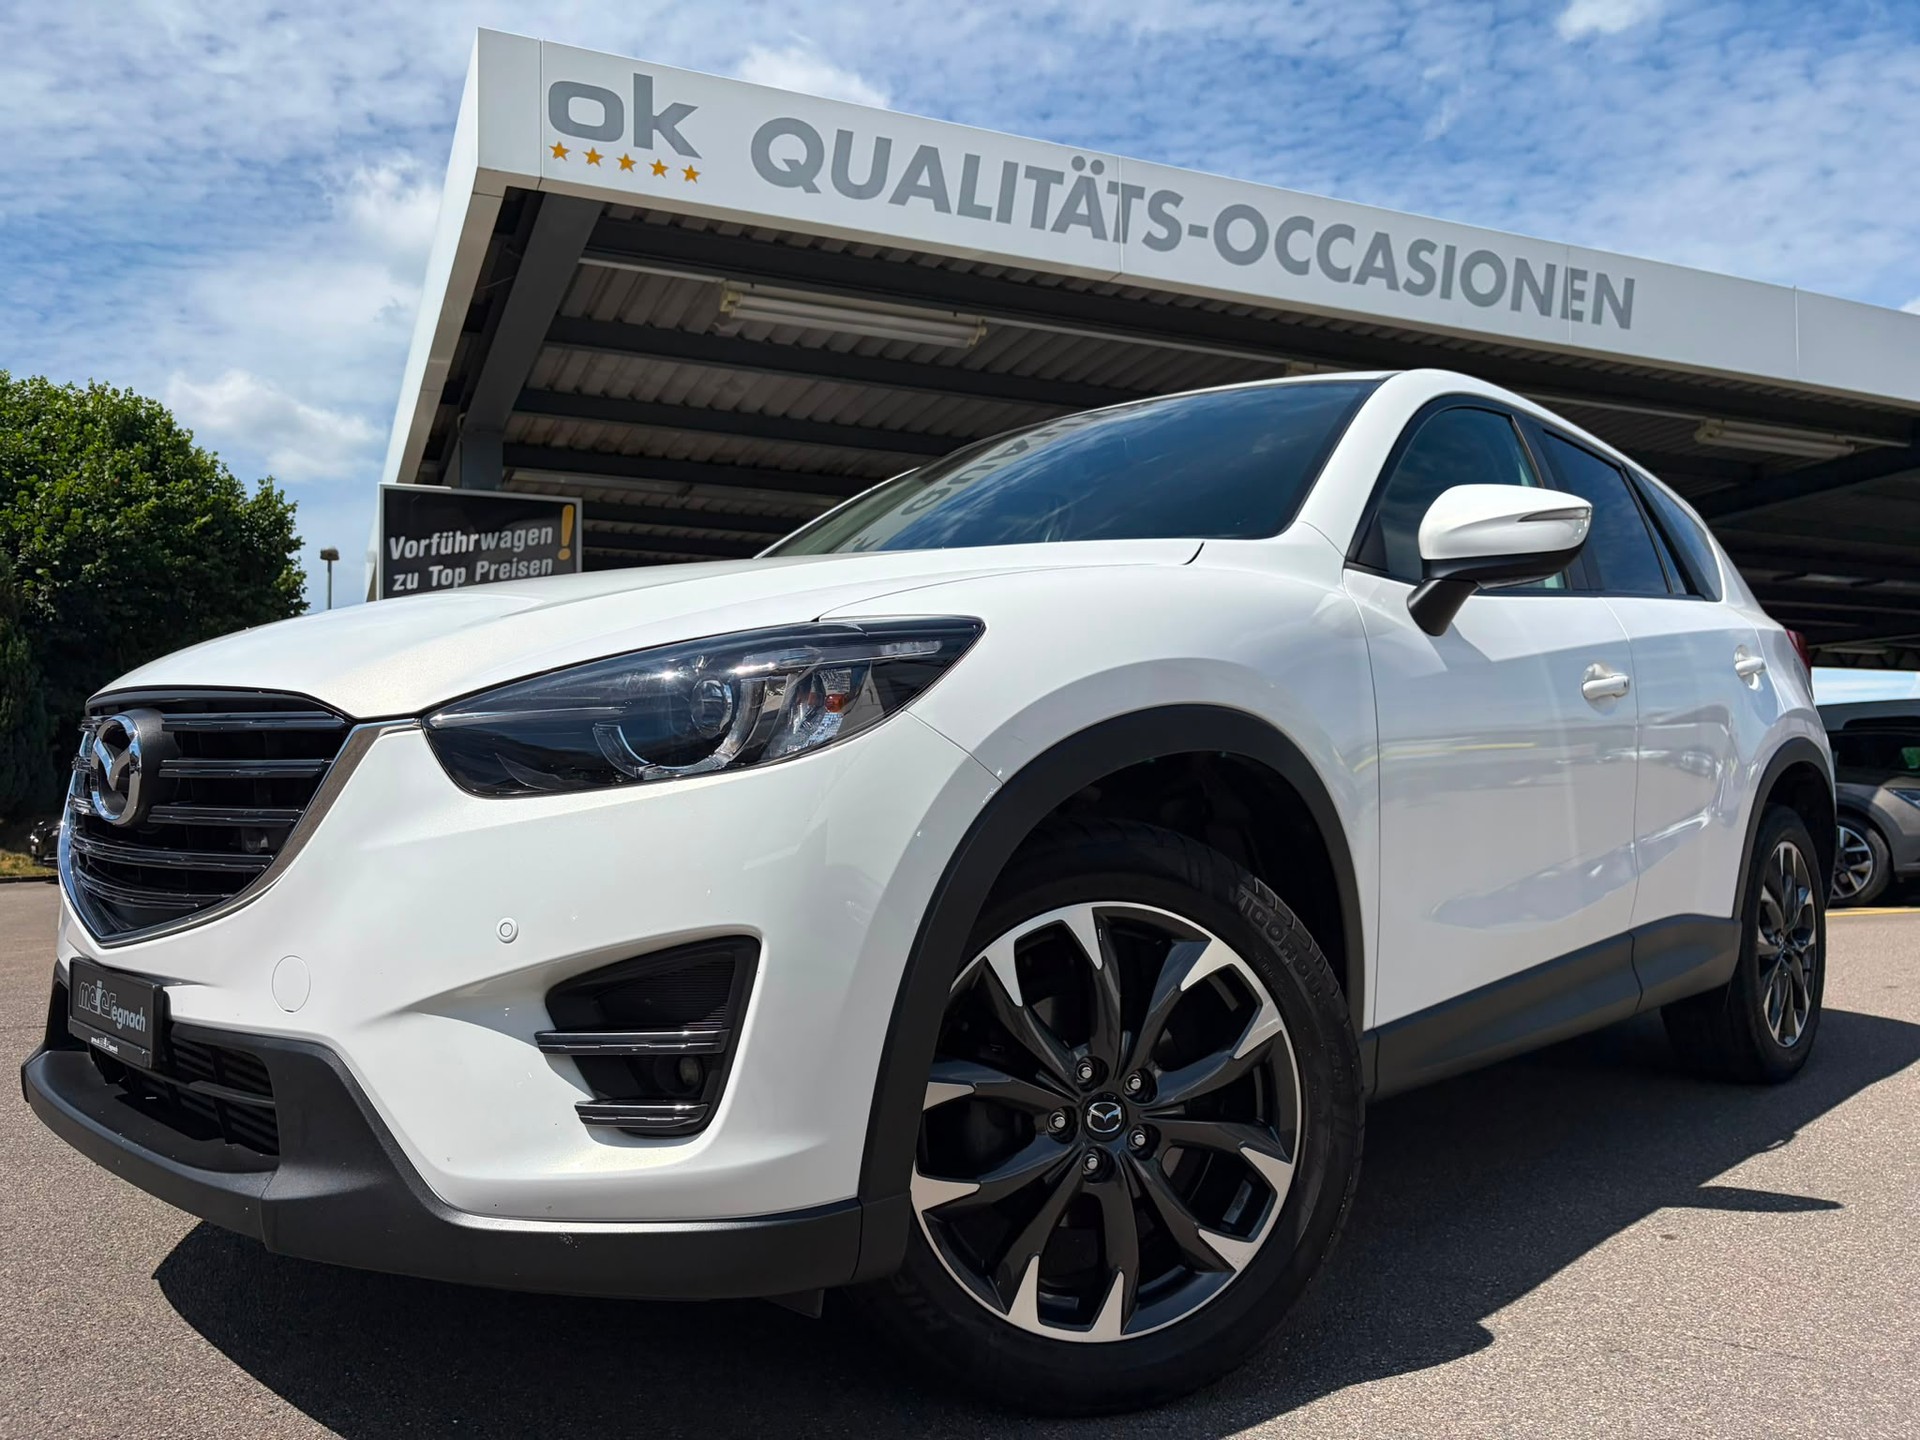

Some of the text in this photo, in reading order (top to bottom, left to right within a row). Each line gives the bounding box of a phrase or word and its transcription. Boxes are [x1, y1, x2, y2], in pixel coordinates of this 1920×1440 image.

[548, 73, 1636, 331] ok QUALITÄTS-OCCASIONEN
[389, 525, 554, 561] Vorführwagen
[392, 557, 554, 592] zu Top Preisen
[111, 1006, 146, 1033] egnach
